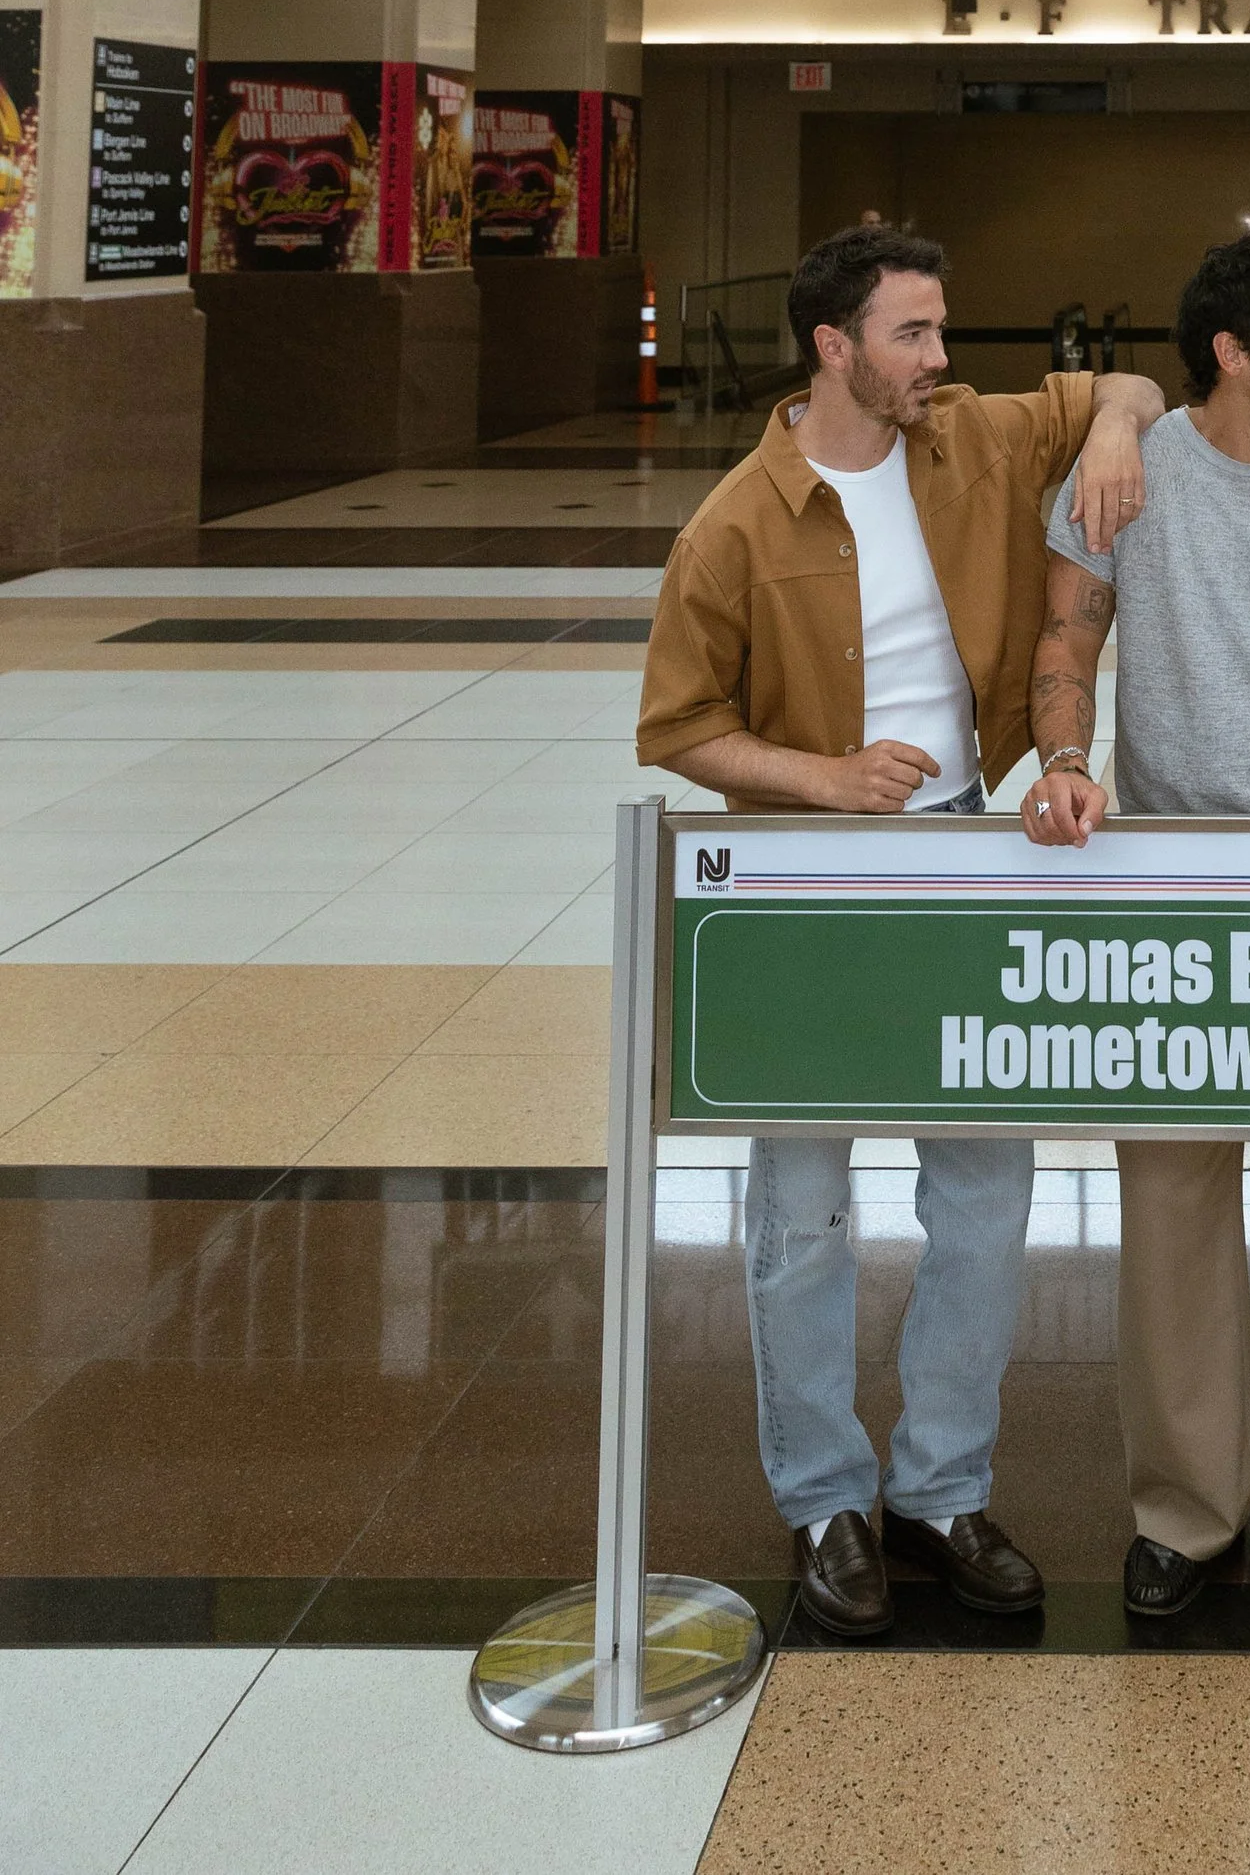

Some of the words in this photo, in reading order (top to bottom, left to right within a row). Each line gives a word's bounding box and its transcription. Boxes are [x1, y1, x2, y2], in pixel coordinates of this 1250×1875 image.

[796, 65, 825, 87] EXIT
[239, 111, 265, 141] ON
[696, 848, 731, 883] NJ
[1001, 929, 1213, 1004] Jonas
